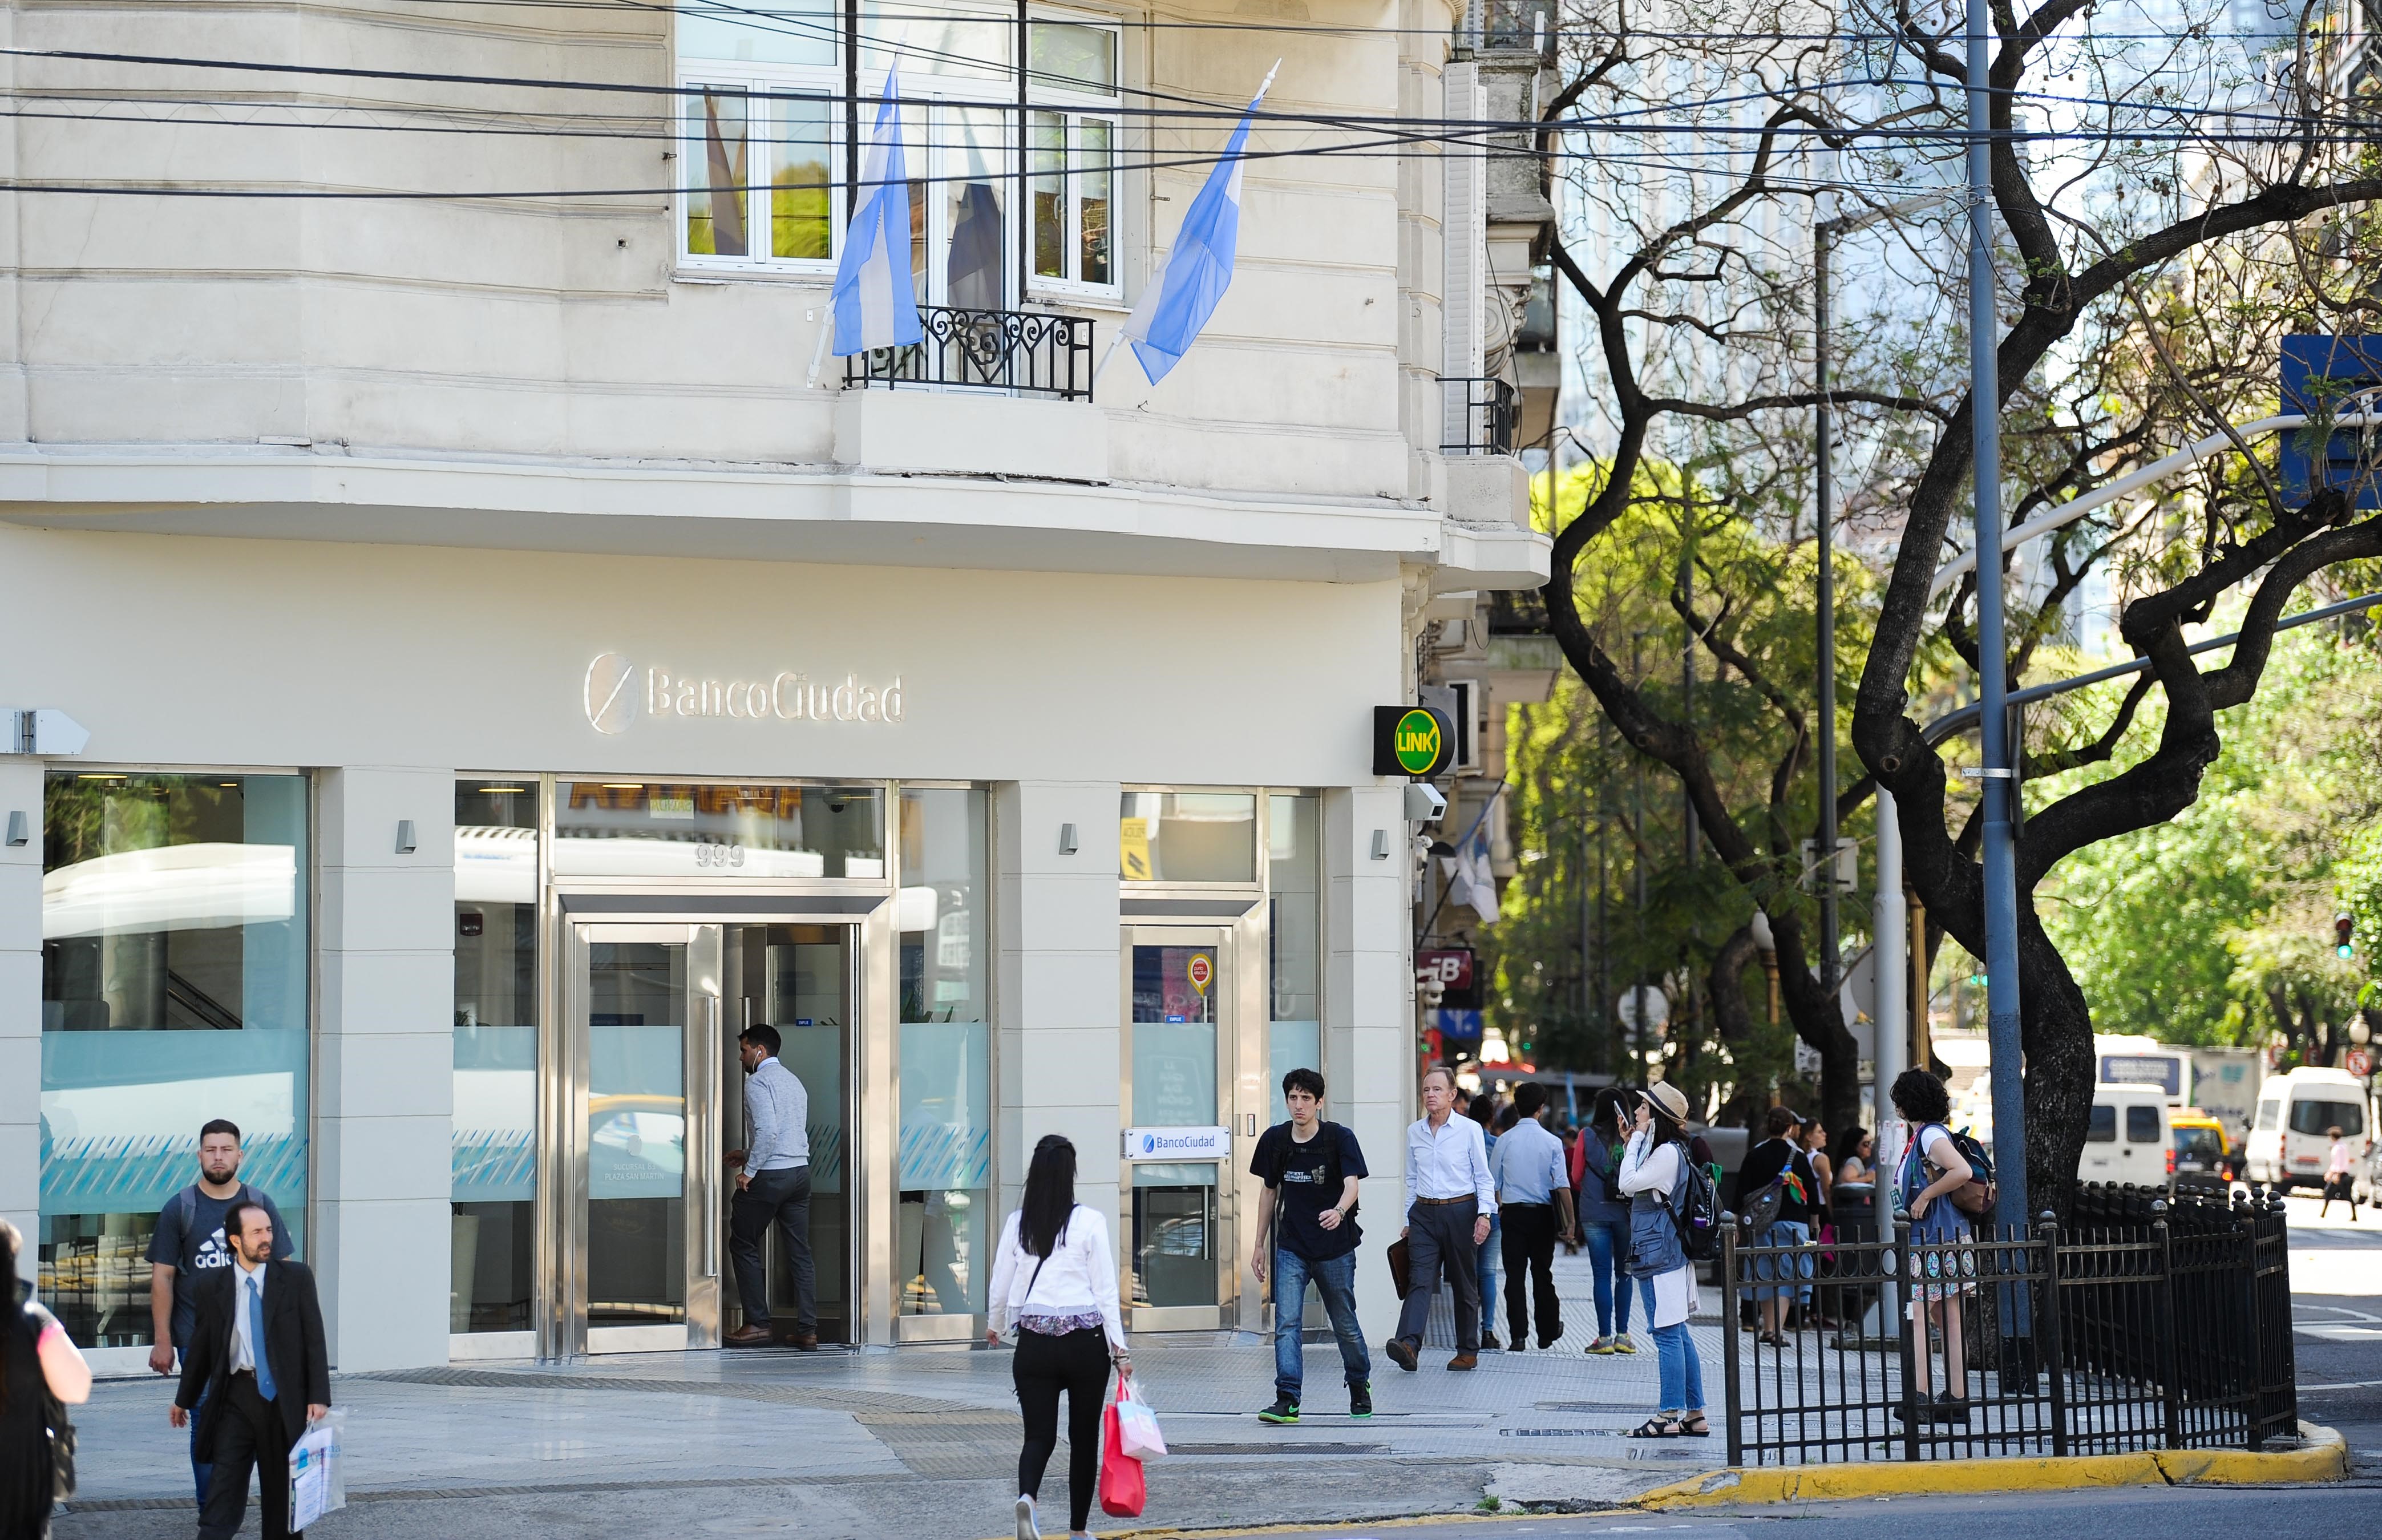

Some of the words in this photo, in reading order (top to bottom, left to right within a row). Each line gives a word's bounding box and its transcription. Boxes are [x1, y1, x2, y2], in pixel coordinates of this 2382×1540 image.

[648, 667, 906, 722] BancoCiudad
[1397, 725, 1436, 752] LINK
[695, 844, 745, 867] 999
[1157, 1135, 1215, 1148] BancoCiudad
